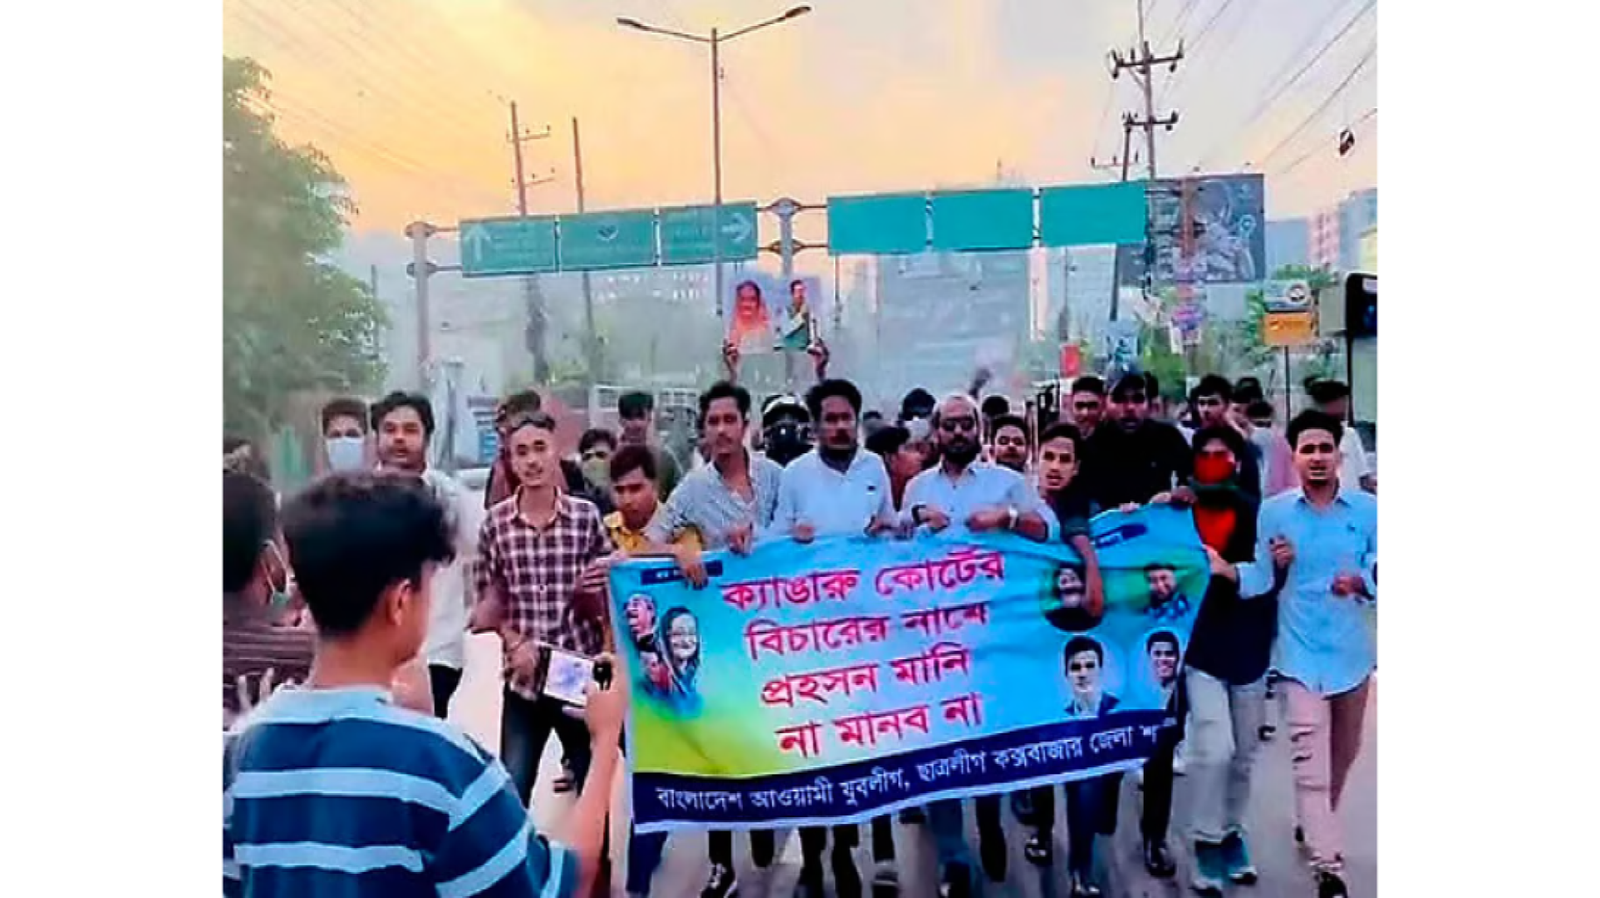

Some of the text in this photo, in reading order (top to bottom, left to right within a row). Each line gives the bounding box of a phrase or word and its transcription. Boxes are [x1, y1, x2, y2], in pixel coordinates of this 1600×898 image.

[746, 618, 889, 660] বিচারের
[761, 642, 968, 707] প্রহসন মানি
[776, 691, 982, 758] না মানব না
[655, 787, 743, 811] বাংলাদেশ
[749, 775, 834, 808] আওয়ামী
[915, 748, 987, 782] ছাত্রলীগ
[1089, 726, 1134, 754] জেলা
